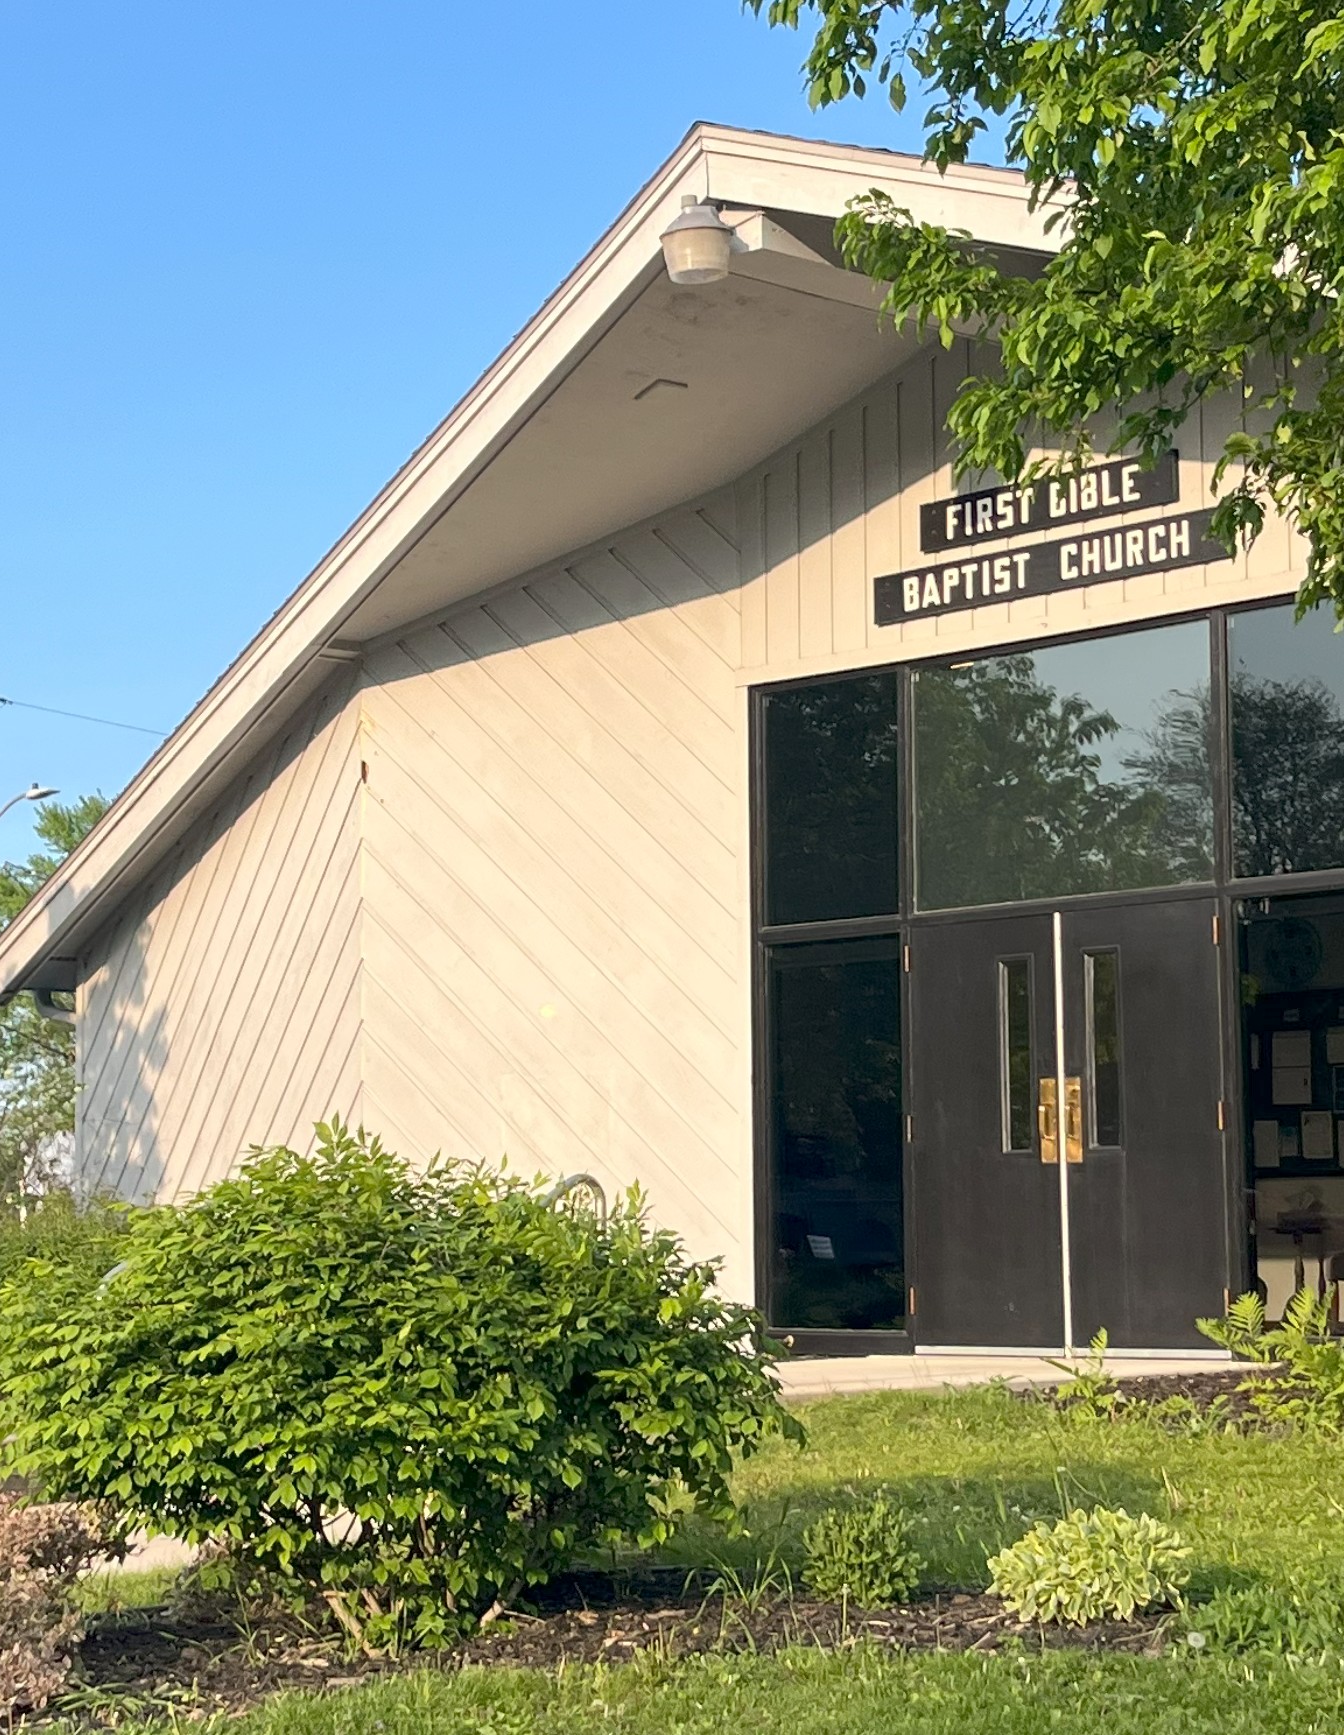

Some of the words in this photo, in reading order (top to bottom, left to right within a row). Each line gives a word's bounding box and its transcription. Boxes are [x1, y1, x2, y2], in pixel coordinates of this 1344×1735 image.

[946, 487, 1034, 540] FIRST
[903, 553, 1031, 612] BAPTIST
[1060, 520, 1191, 581] CHURCH
